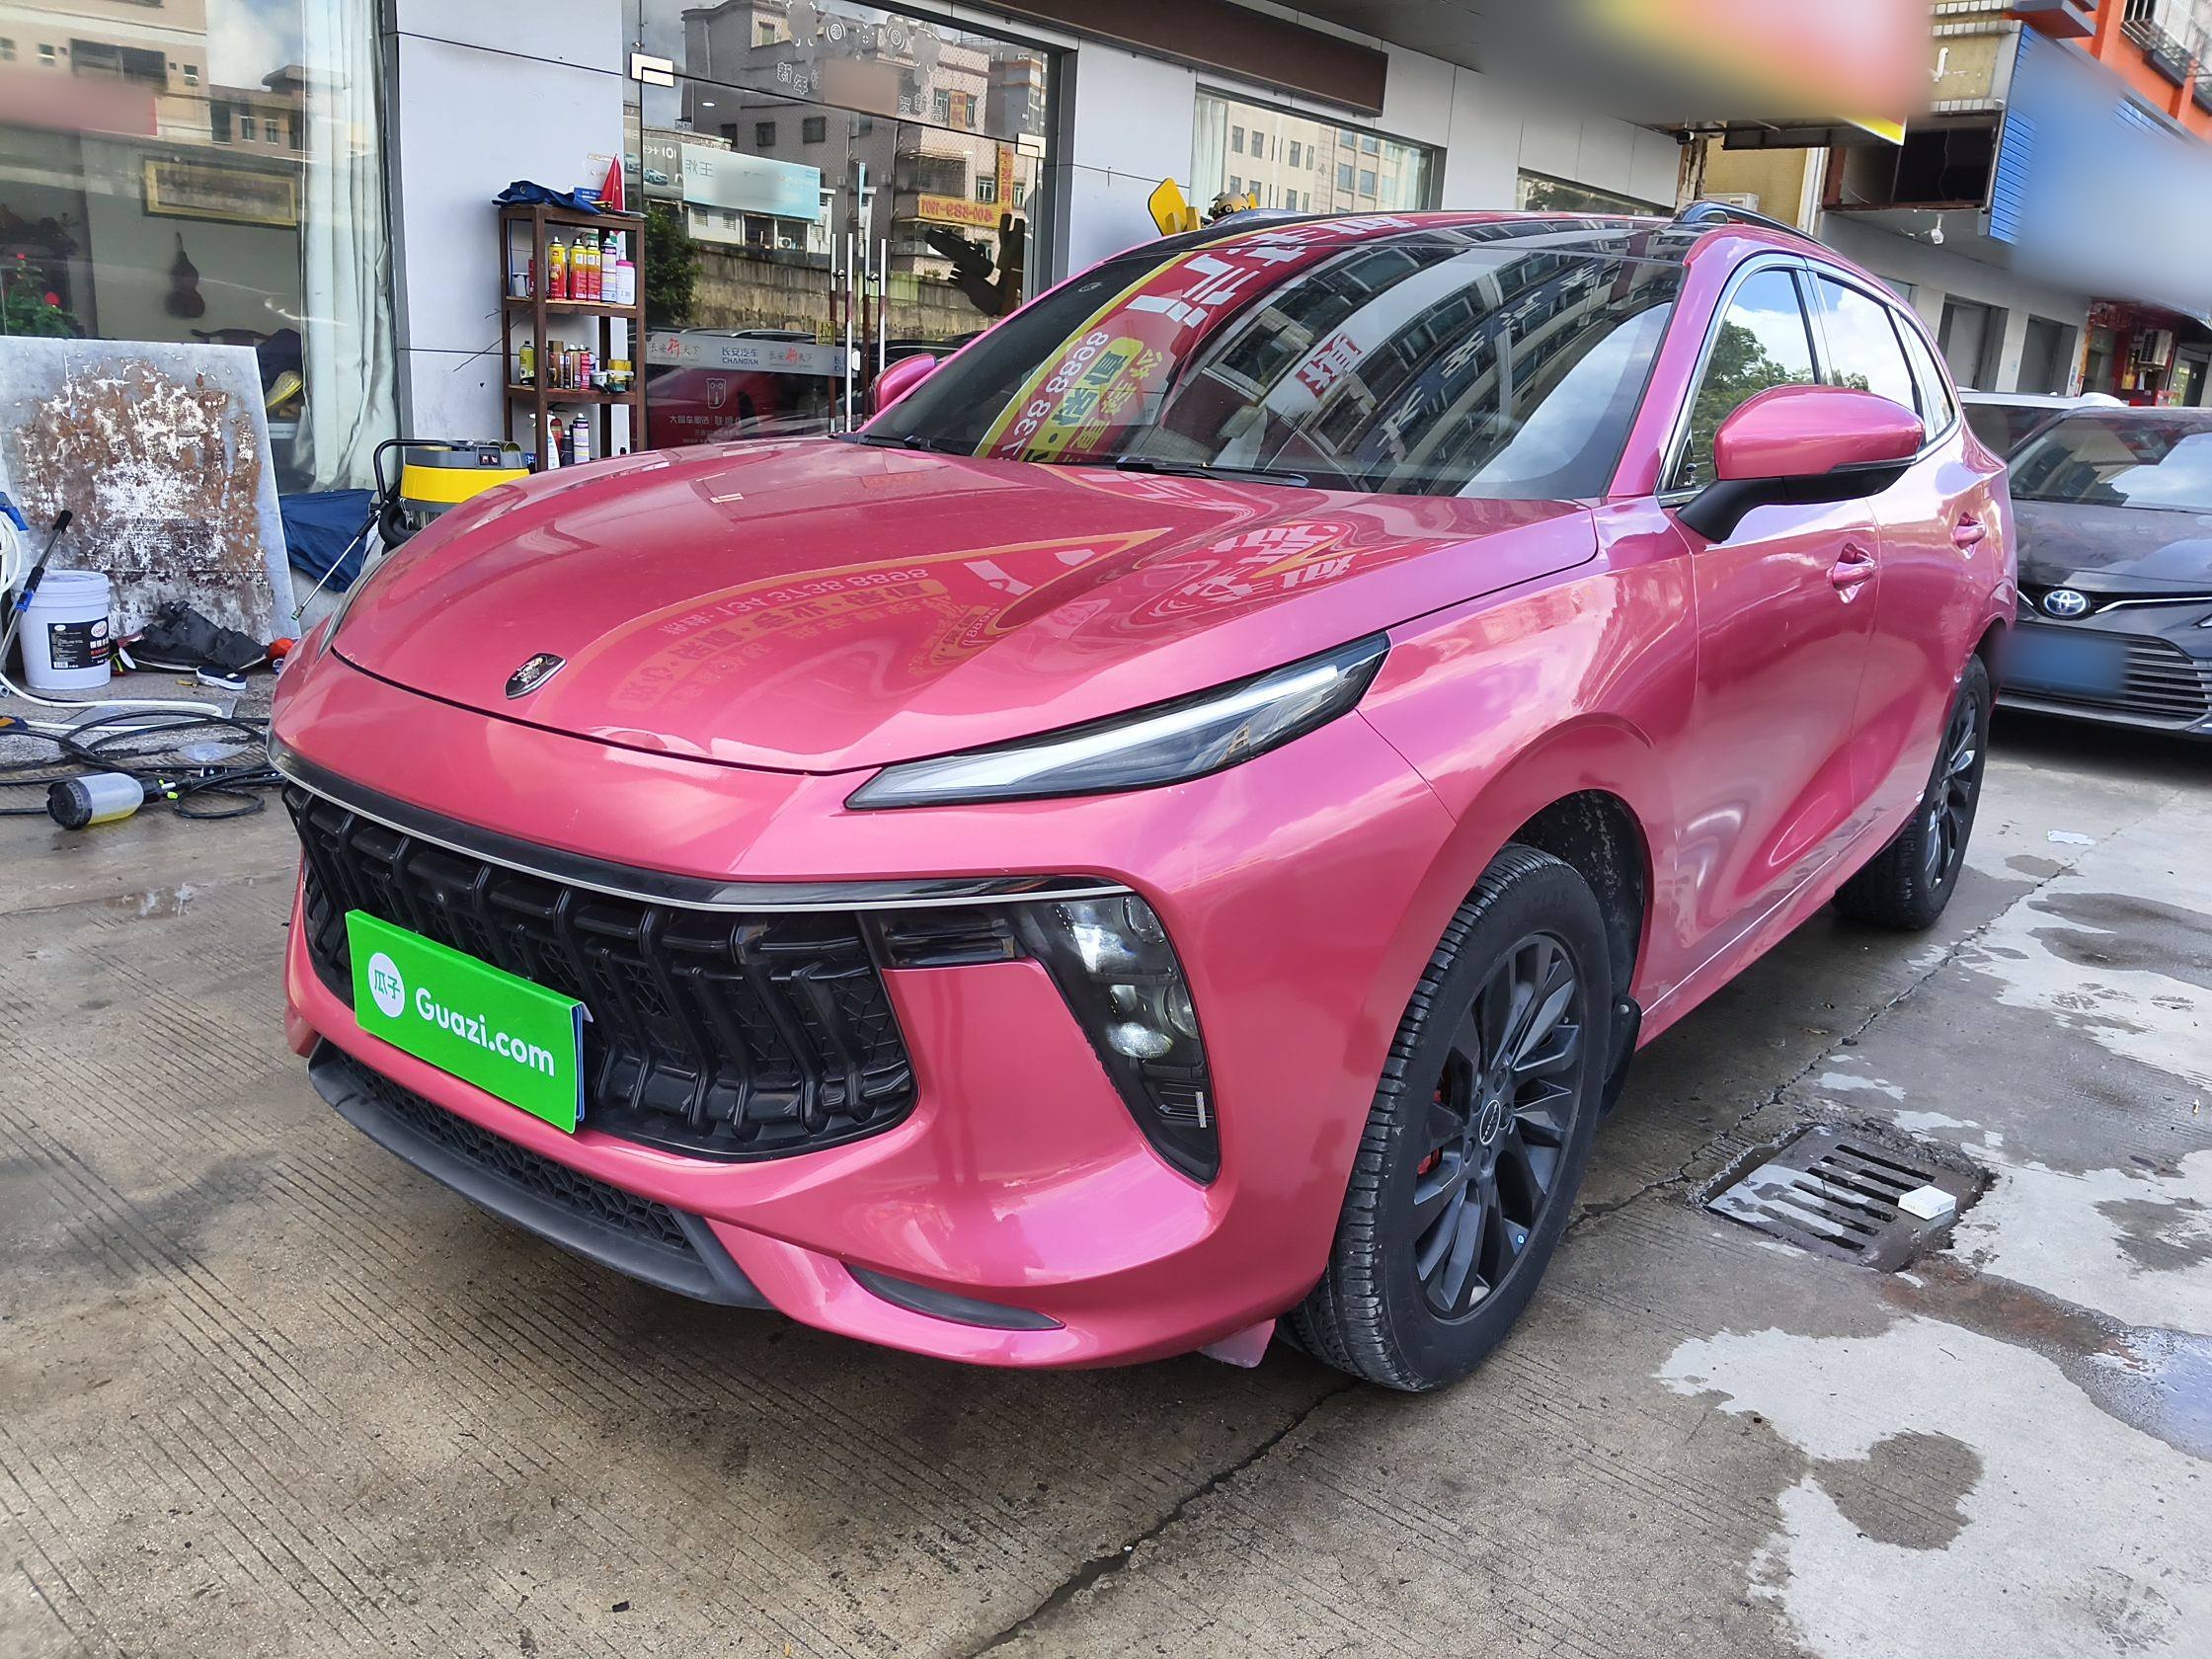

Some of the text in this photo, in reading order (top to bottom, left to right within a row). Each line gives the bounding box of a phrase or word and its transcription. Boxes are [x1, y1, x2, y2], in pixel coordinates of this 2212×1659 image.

[722, 346, 759, 357] 长安汽车
[722, 356, 759, 366] CHANGAN
[372, 969, 402, 1001] 瓜子
[415, 988, 555, 1077] Guazi.com
